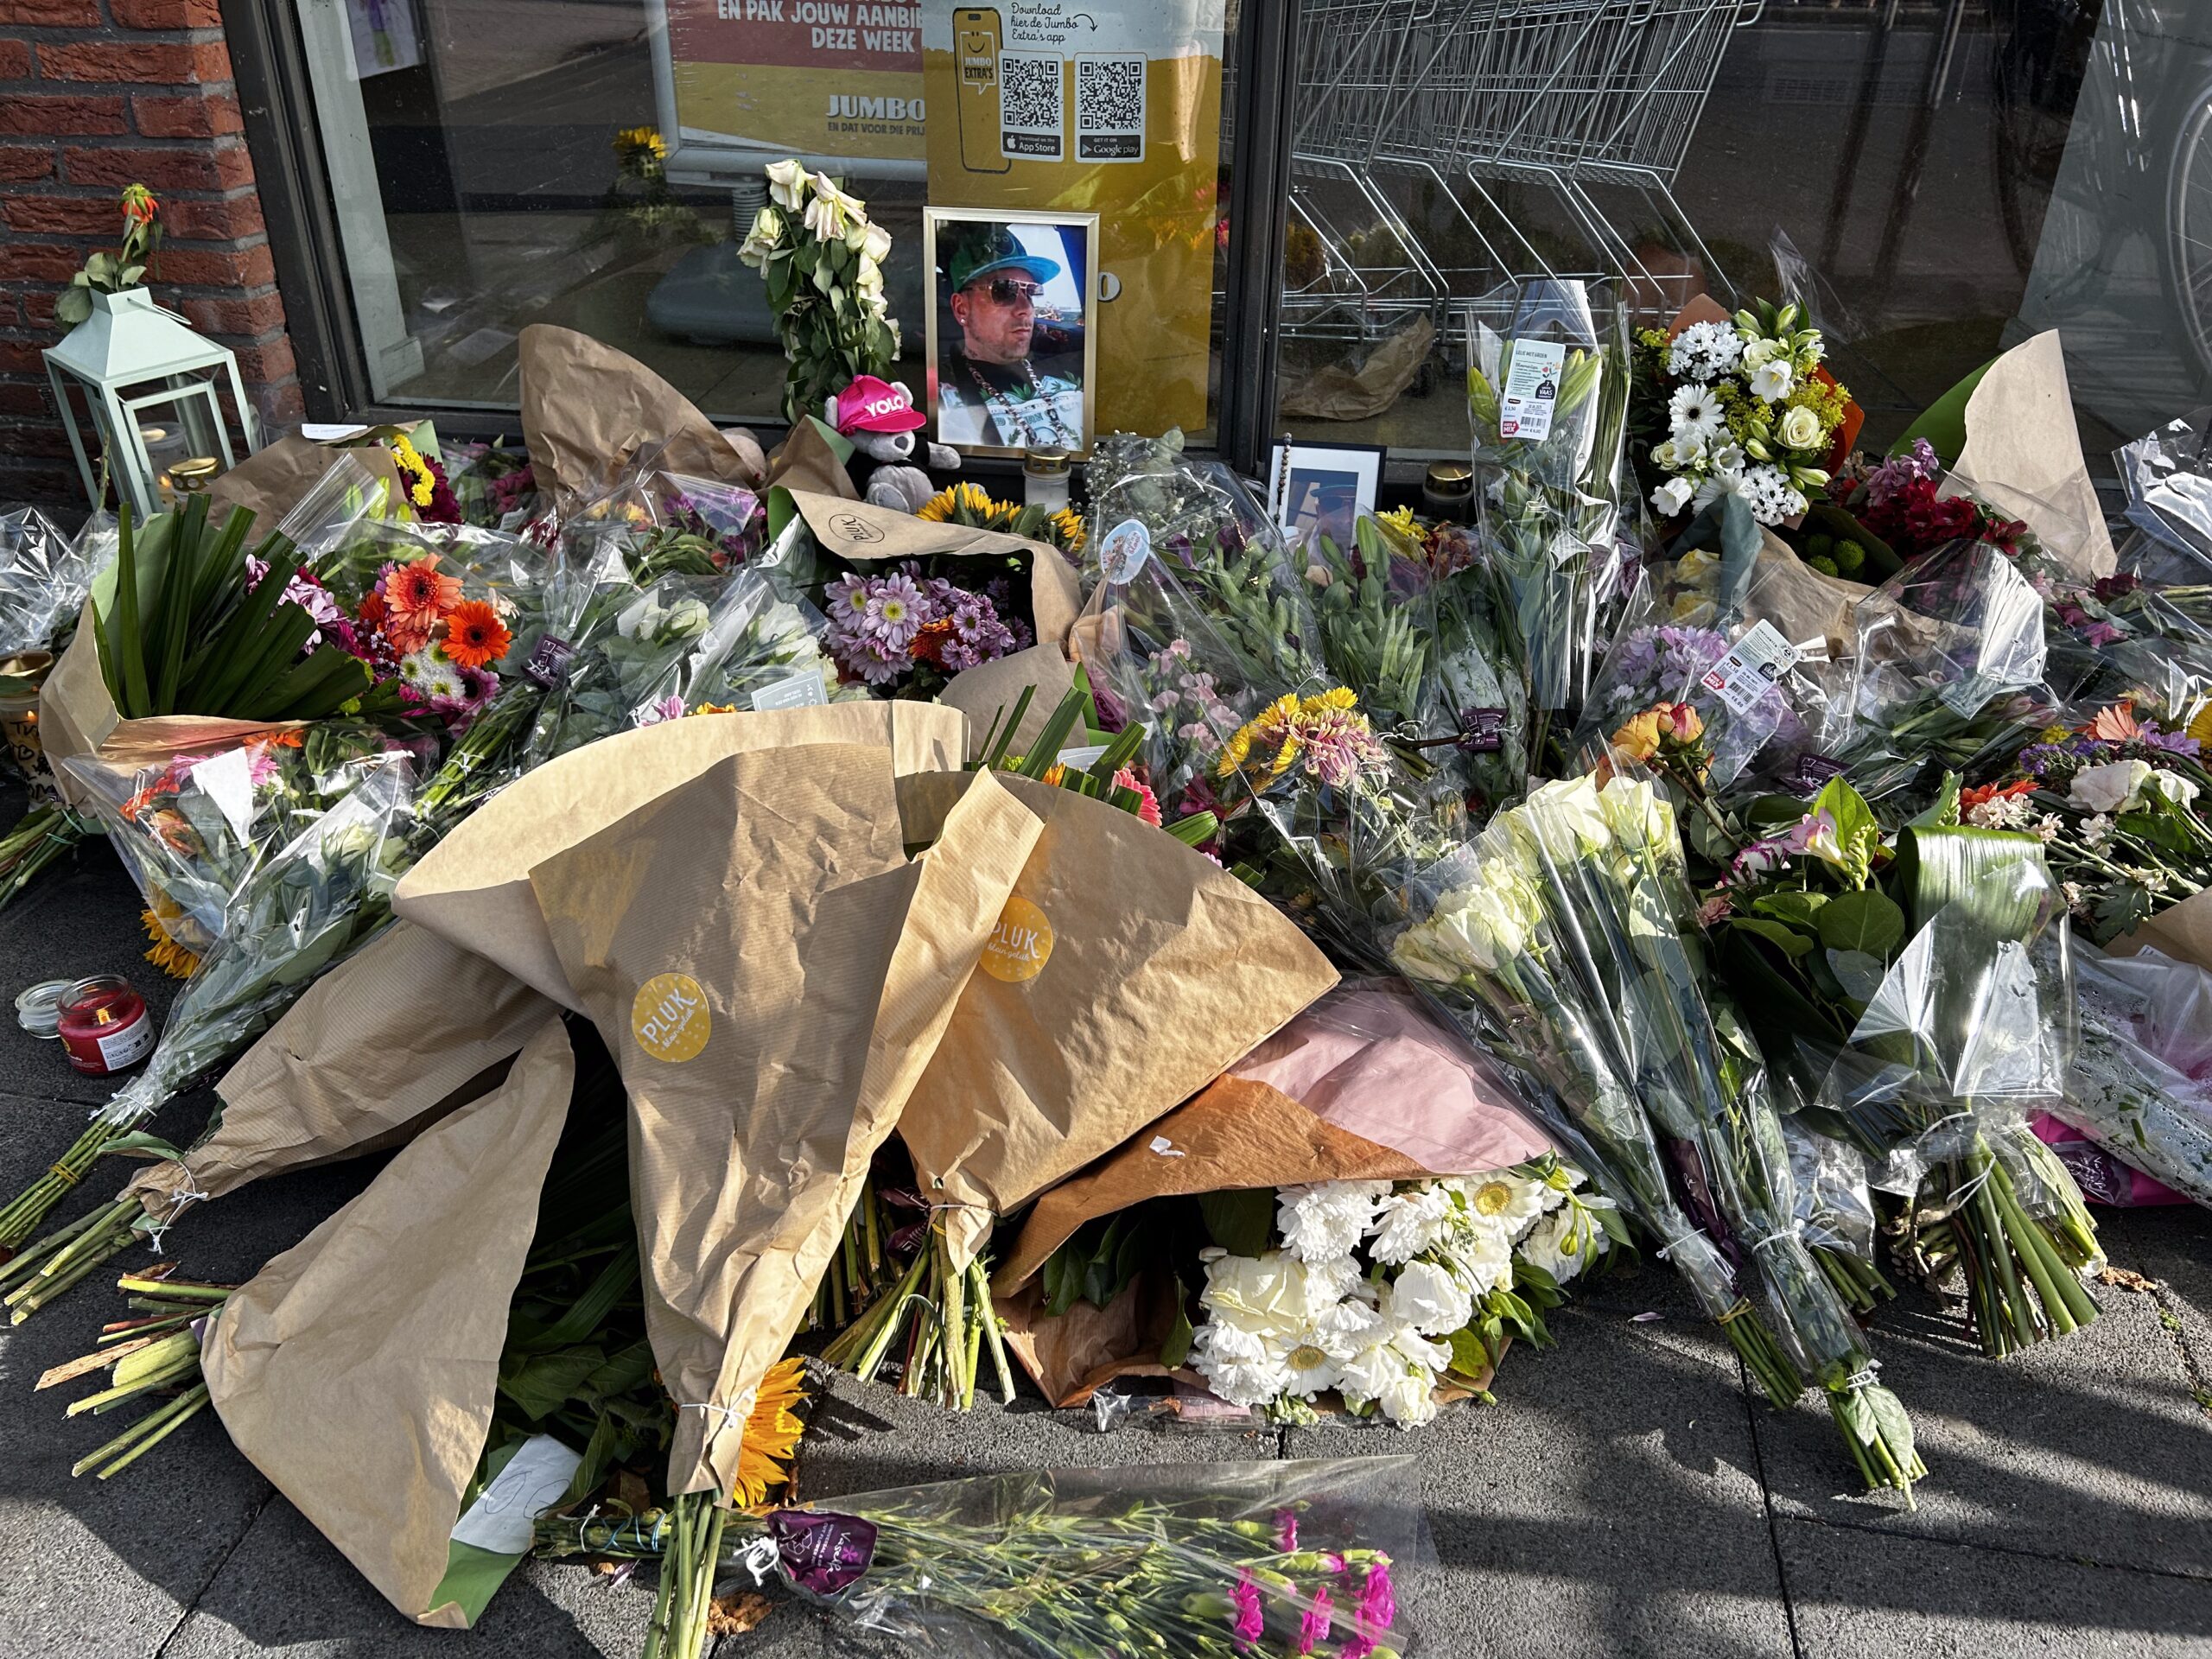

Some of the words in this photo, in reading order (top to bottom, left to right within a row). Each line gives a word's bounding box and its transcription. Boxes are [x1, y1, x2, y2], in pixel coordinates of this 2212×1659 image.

[718, 1, 741, 20] EN
[746, 1, 785, 22] PAK
[791, 3, 849, 25] JOUW
[1011, 3, 1061, 15] Download
[1011, 16, 1029, 28] hier
[1031, 17, 1042, 28] de
[1044, 17, 1078, 29] Jumbo
[812, 27, 856, 50] DEZE
[862, 30, 914, 53] WEEK
[1012, 29, 1046, 41] Extra's
[1046, 35, 1065, 45] app
[964, 57, 992, 67] JUMBO
[964, 67, 994, 79] EXTRA'S
[825, 94, 926, 123] JUMBO
[828, 122, 838, 132] EN
[841, 123, 859, 132] DAT
[861, 124, 887, 134] VOOR
[889, 124, 903, 135] DIE
[1019, 143, 1034, 152] App
[1035, 143, 1055, 152] Store
[1093, 144, 1122, 156] Google
[1122, 146, 1139, 155] play
[865, 395, 904, 417] YOLO
[841, 518, 869, 541] PLUK
[641, 988, 697, 1044] PLUK
